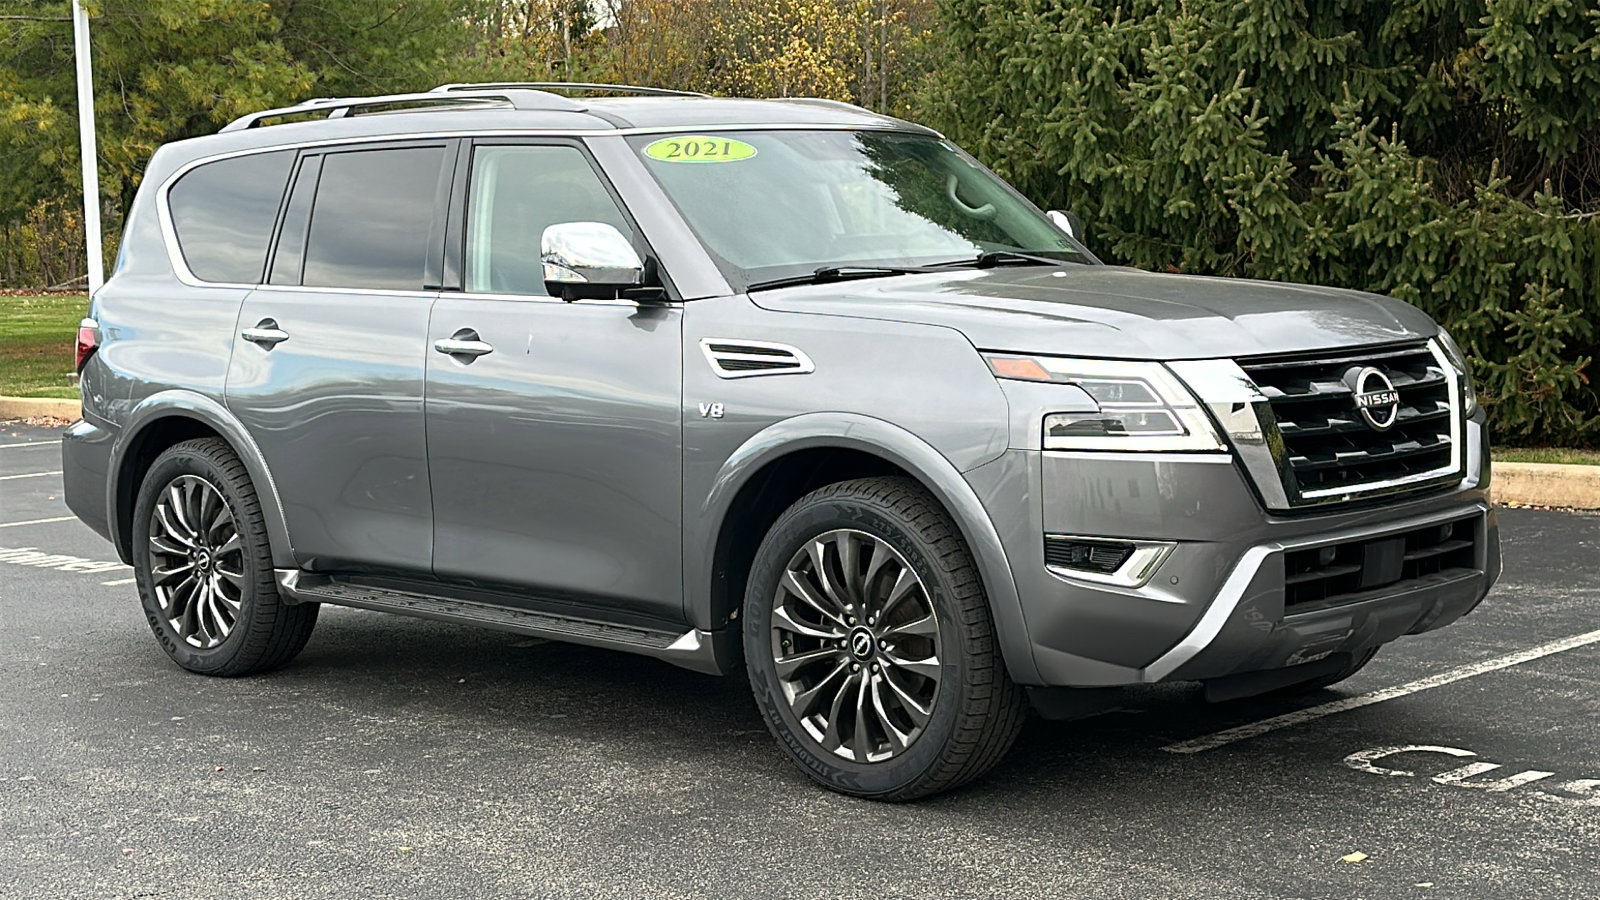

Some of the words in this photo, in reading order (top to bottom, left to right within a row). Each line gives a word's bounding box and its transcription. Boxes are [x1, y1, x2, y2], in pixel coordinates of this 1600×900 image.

[666, 141, 731, 158] 2021
[1357, 392, 1399, 407] NISSAN
[698, 402, 725, 418] V8
[780, 729, 829, 776] STEADFAST
